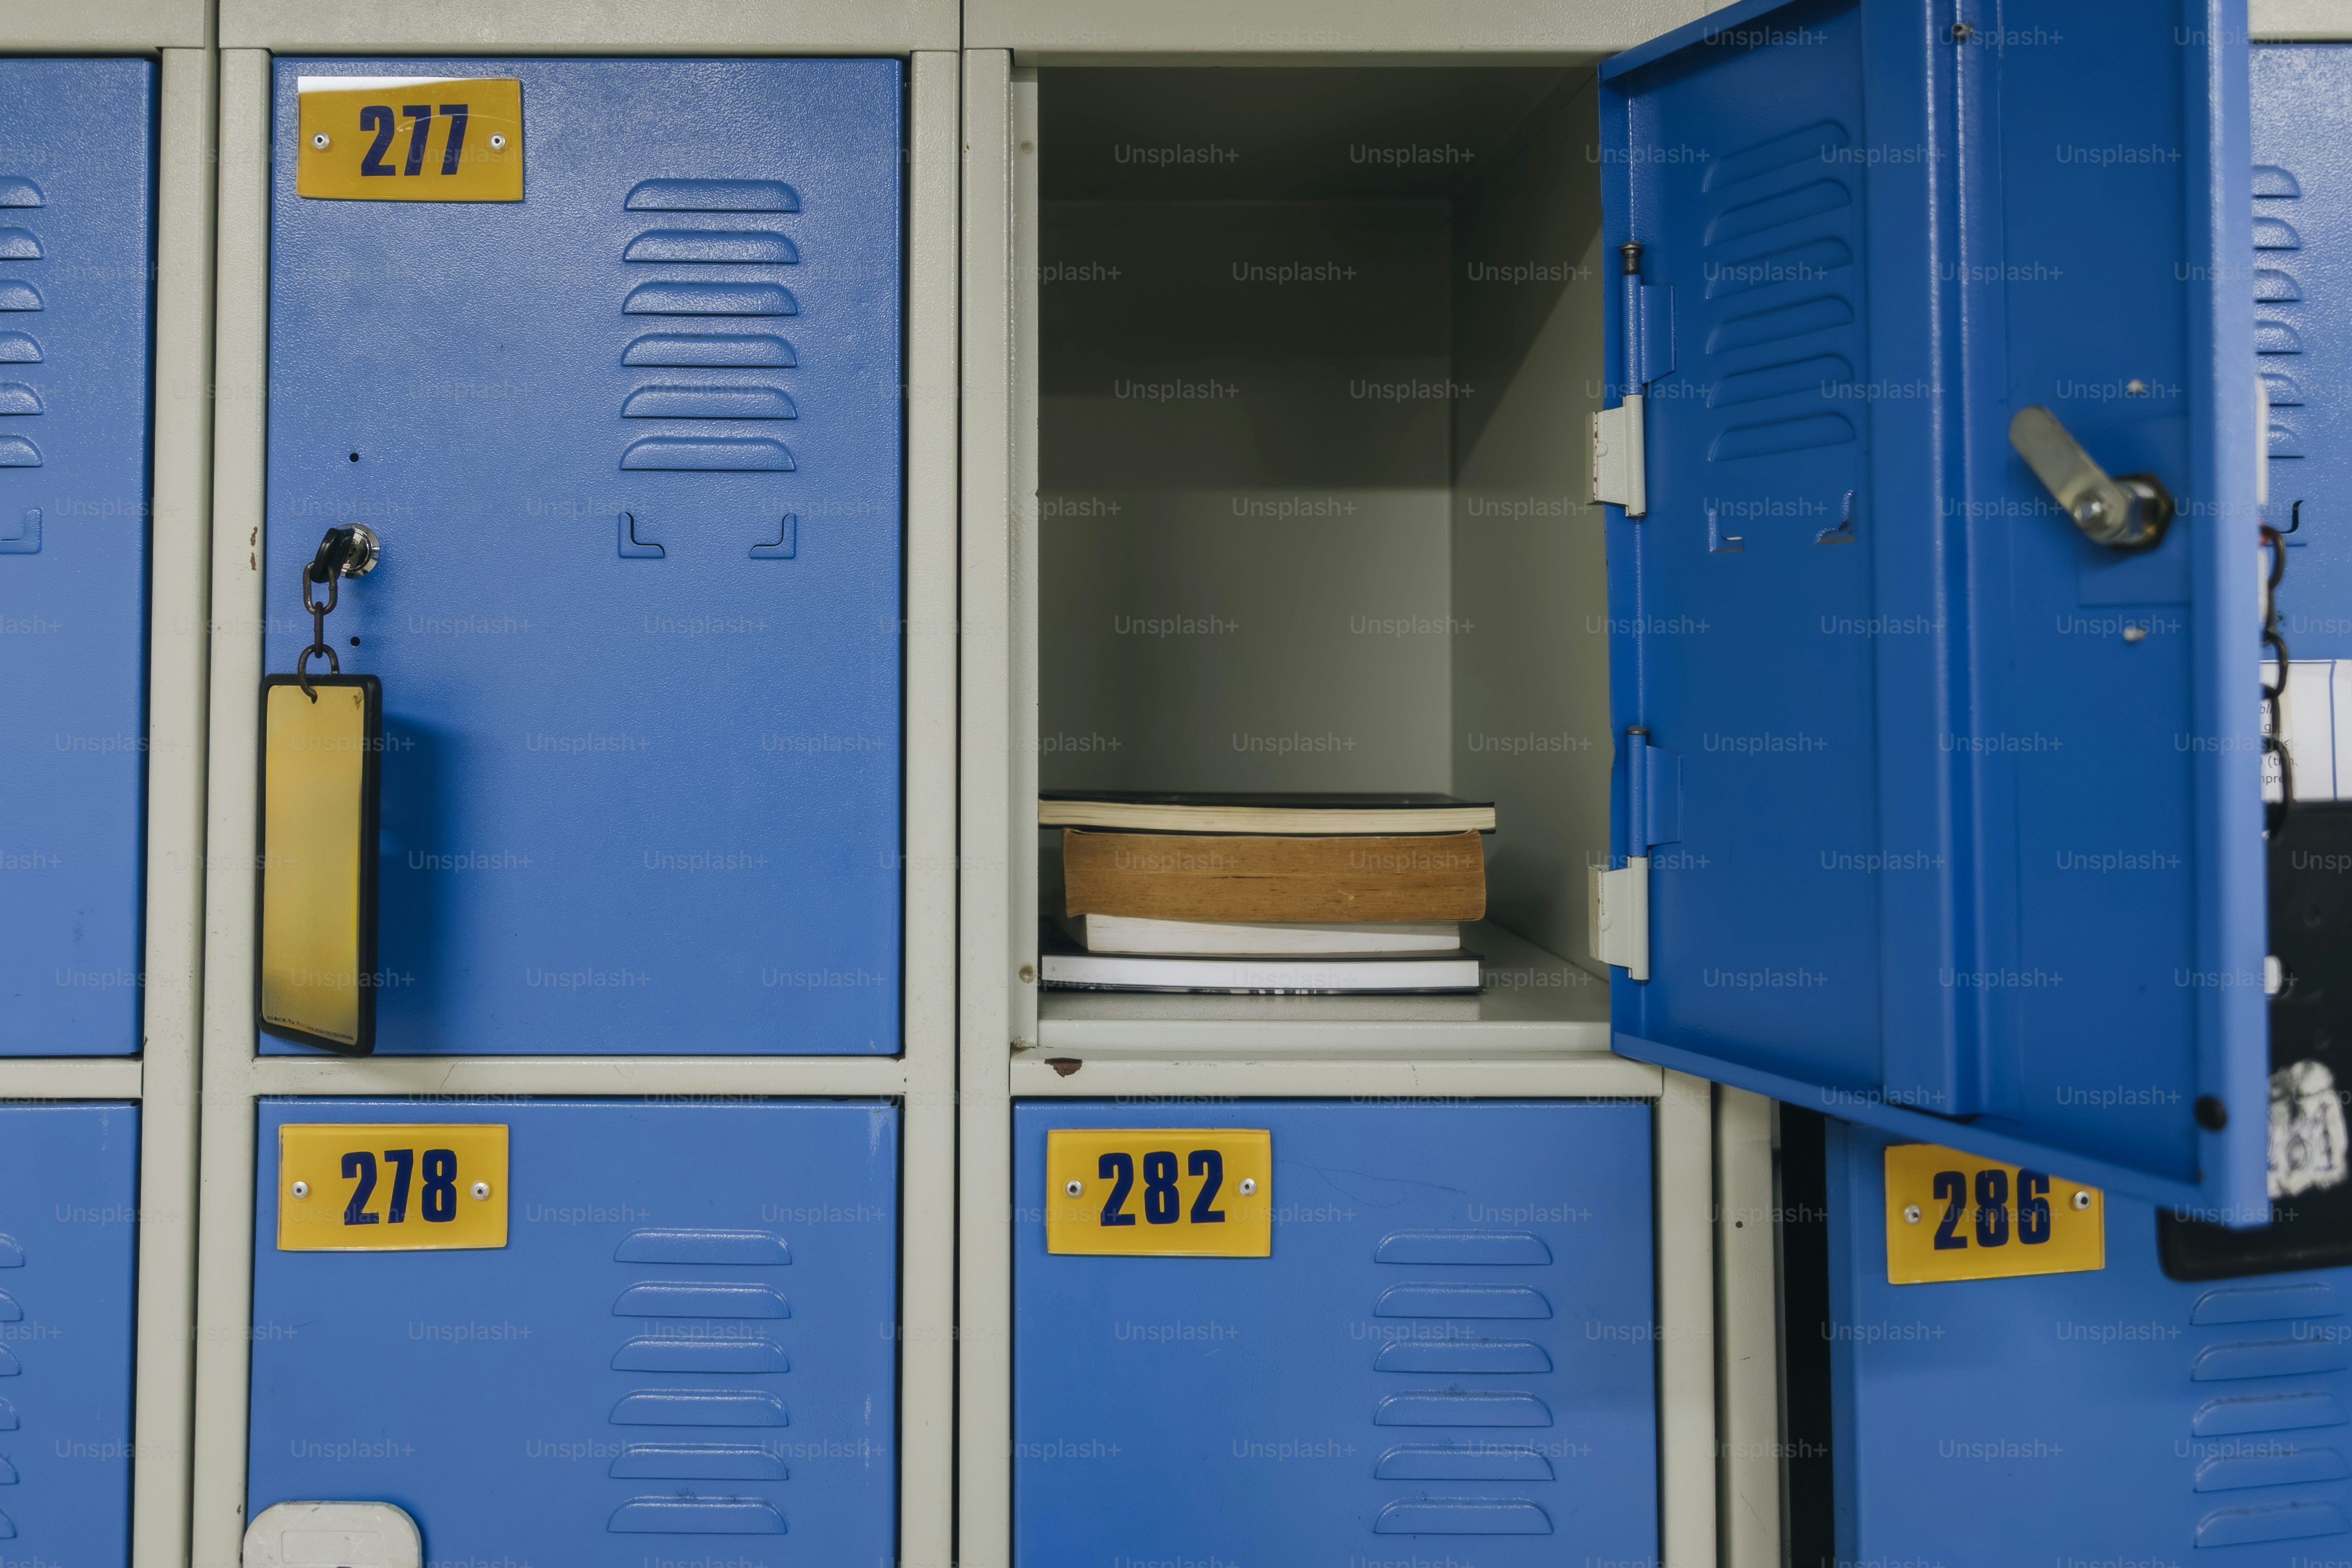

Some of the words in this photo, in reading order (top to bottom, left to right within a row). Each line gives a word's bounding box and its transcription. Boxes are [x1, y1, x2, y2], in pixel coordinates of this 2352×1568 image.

[360, 104, 468, 176] 277
[342, 1149, 457, 1226] 278
[1099, 1149, 1225, 1227] 282
[1933, 1168, 2050, 1250] 286
